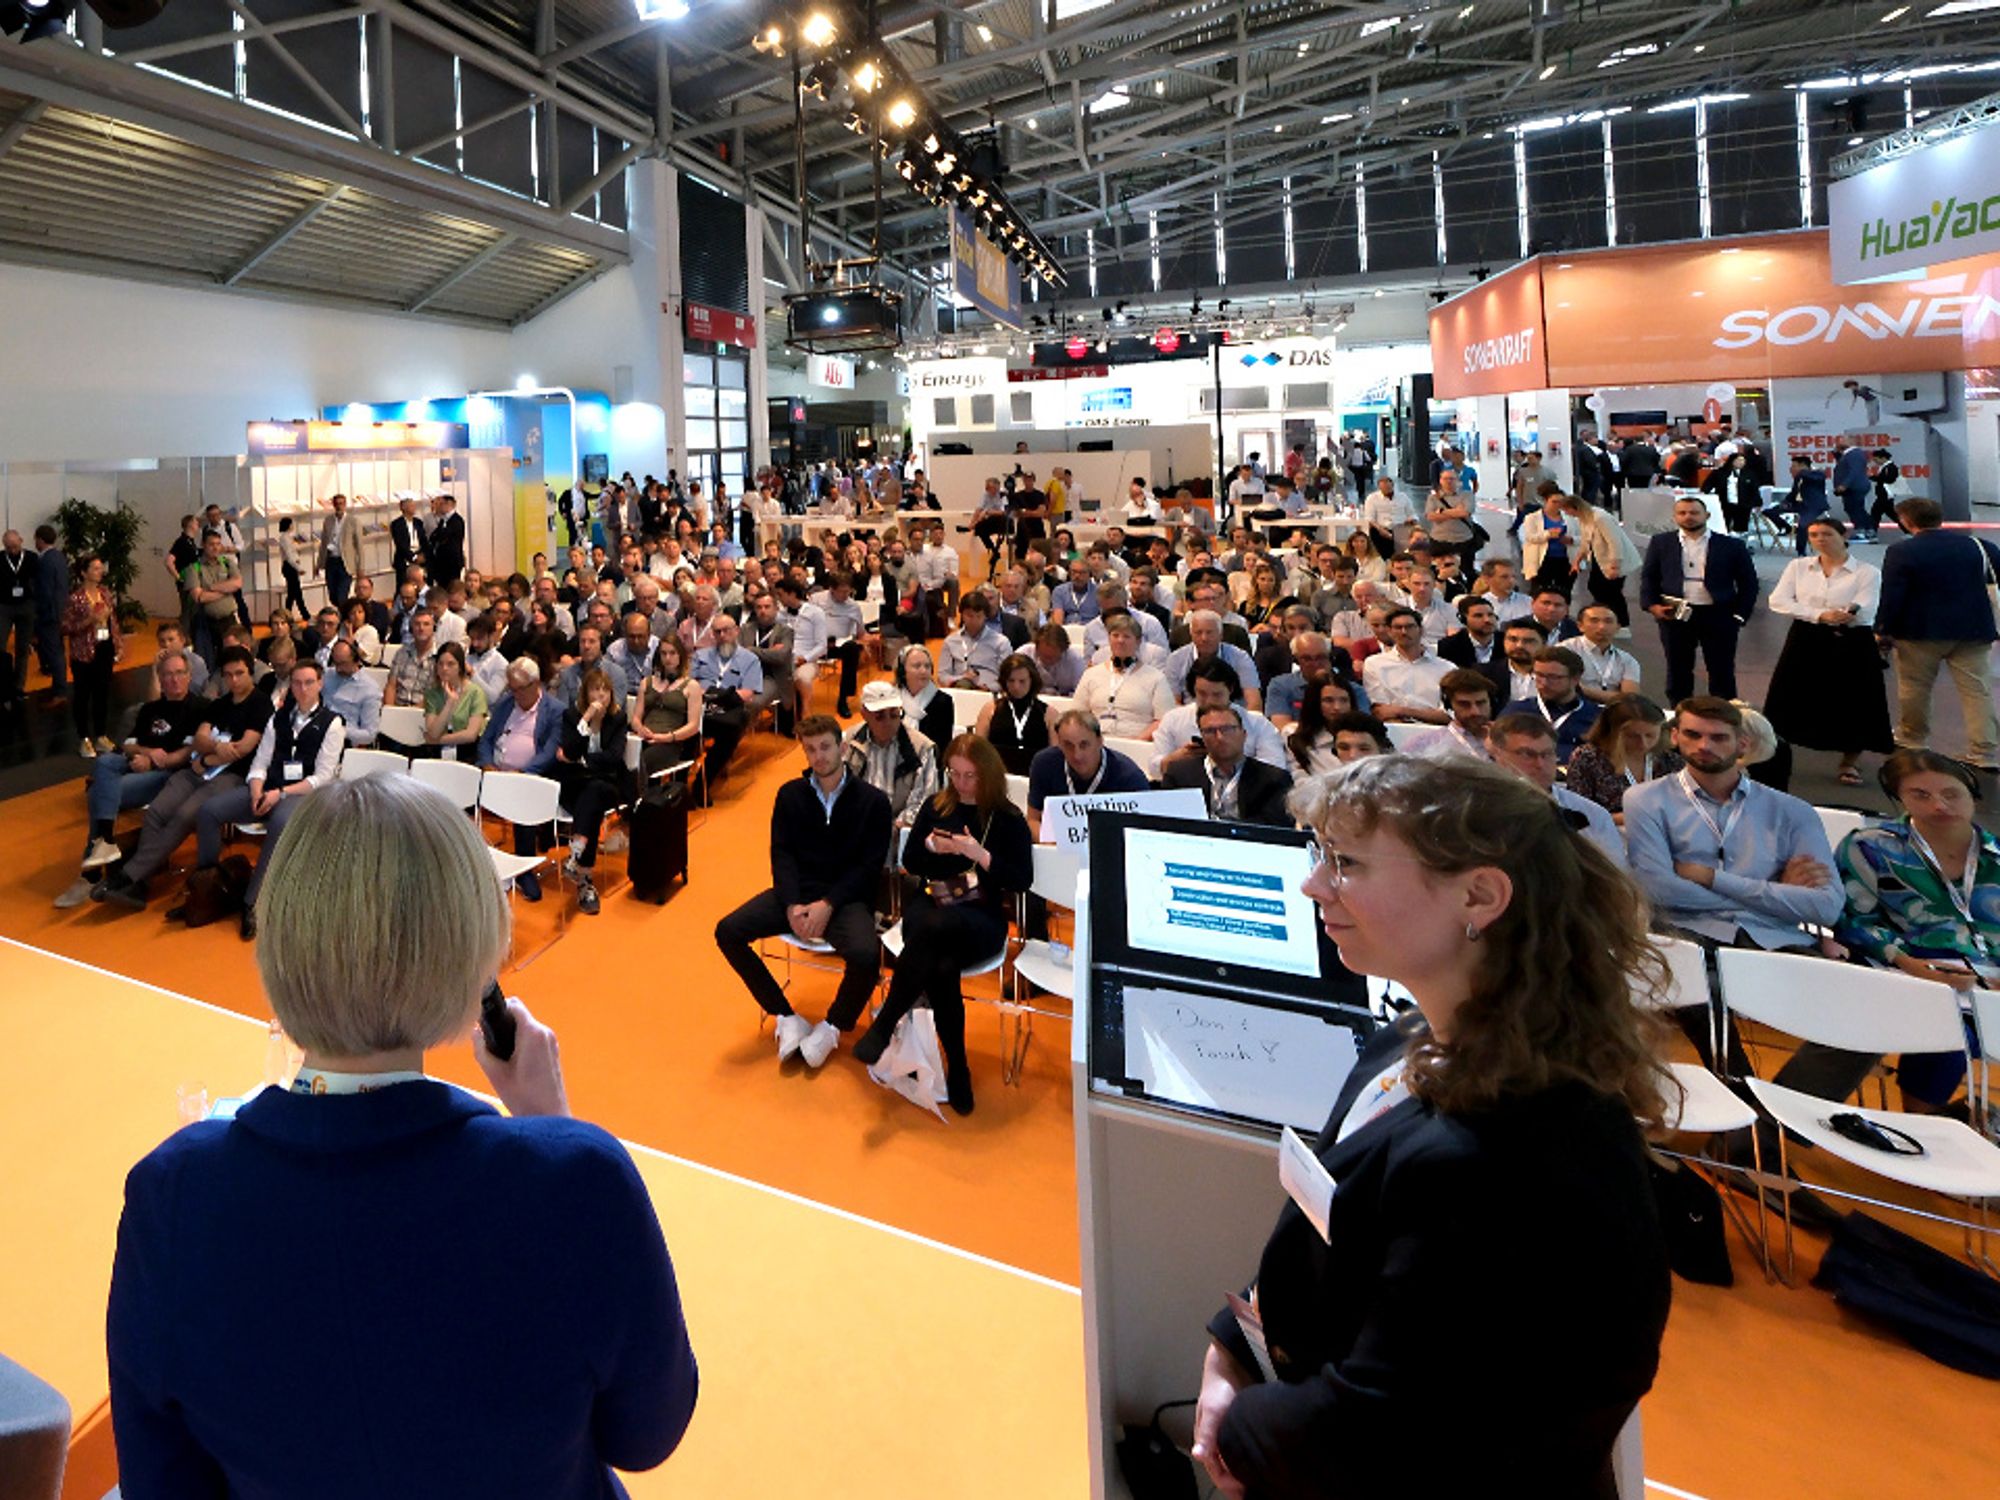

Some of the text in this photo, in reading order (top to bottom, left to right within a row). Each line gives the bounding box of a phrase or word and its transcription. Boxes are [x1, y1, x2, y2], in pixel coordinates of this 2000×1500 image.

[1289, 349, 1332, 366] DAS
[922, 371, 986, 389] Energy
[1787, 433, 1901, 449] SPEIER-
